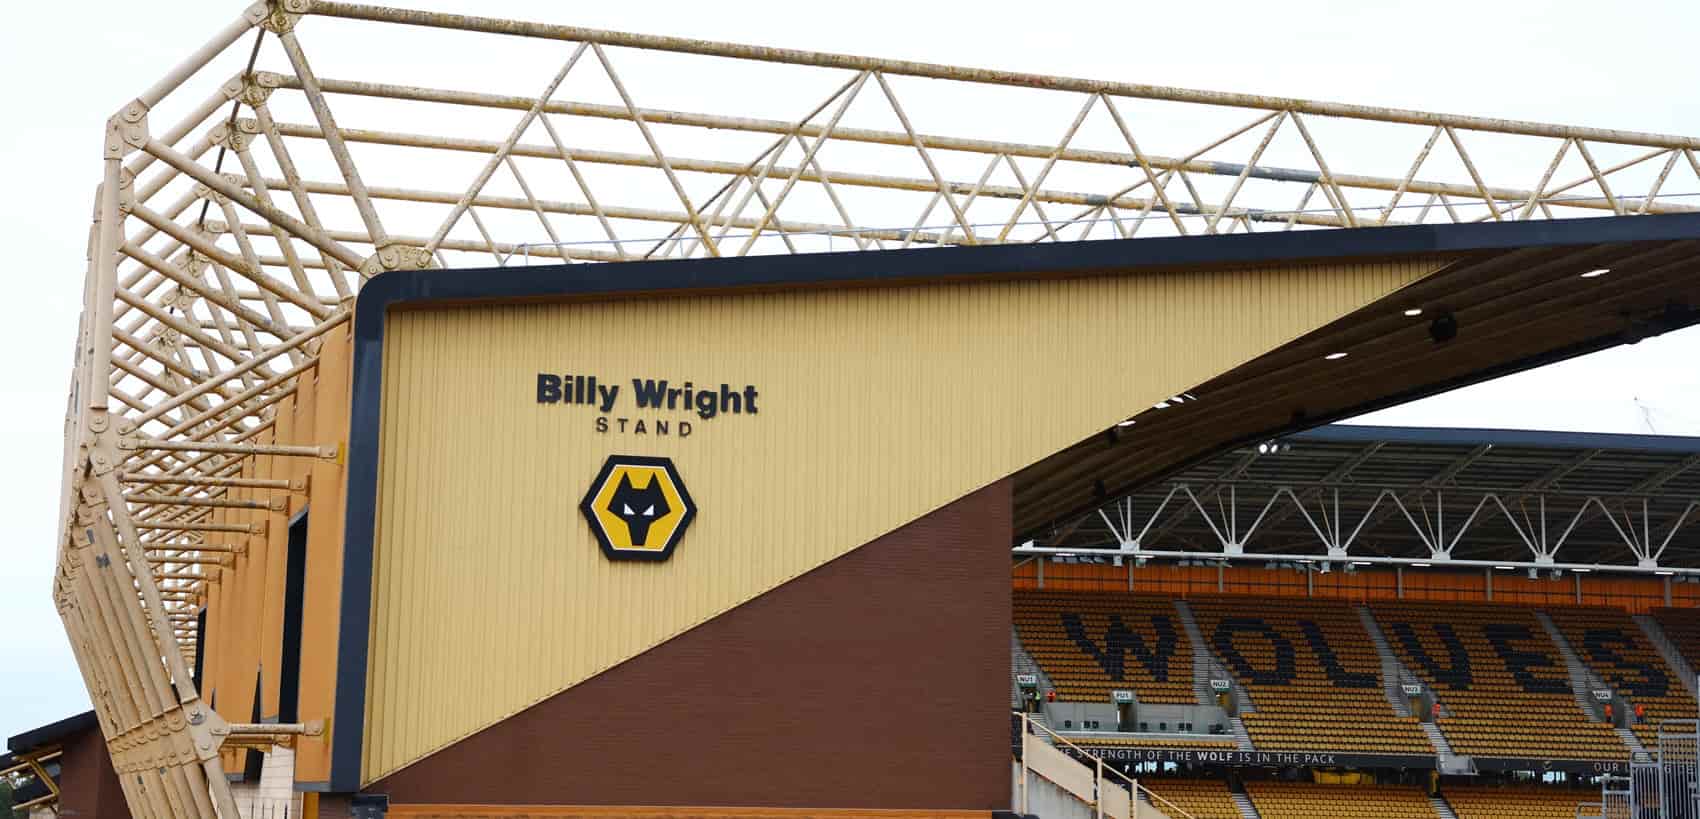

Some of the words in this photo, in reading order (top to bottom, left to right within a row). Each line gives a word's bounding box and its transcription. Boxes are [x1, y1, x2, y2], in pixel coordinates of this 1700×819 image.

[536, 373, 620, 413] Billy
[632, 378, 759, 420] Wright
[595, 416, 693, 438] STAND
[1060, 613, 1671, 699] WOLVES
[1147, 750, 1162, 760] OF
[1168, 751, 1191, 761] THE
[1197, 751, 1233, 762] WOLF
[1239, 752, 1251, 762] IS
[1257, 753, 1270, 763] IN
[1276, 753, 1299, 764] THE
[1304, 754, 1336, 764] PACK
[1593, 762, 1619, 772] OUR
